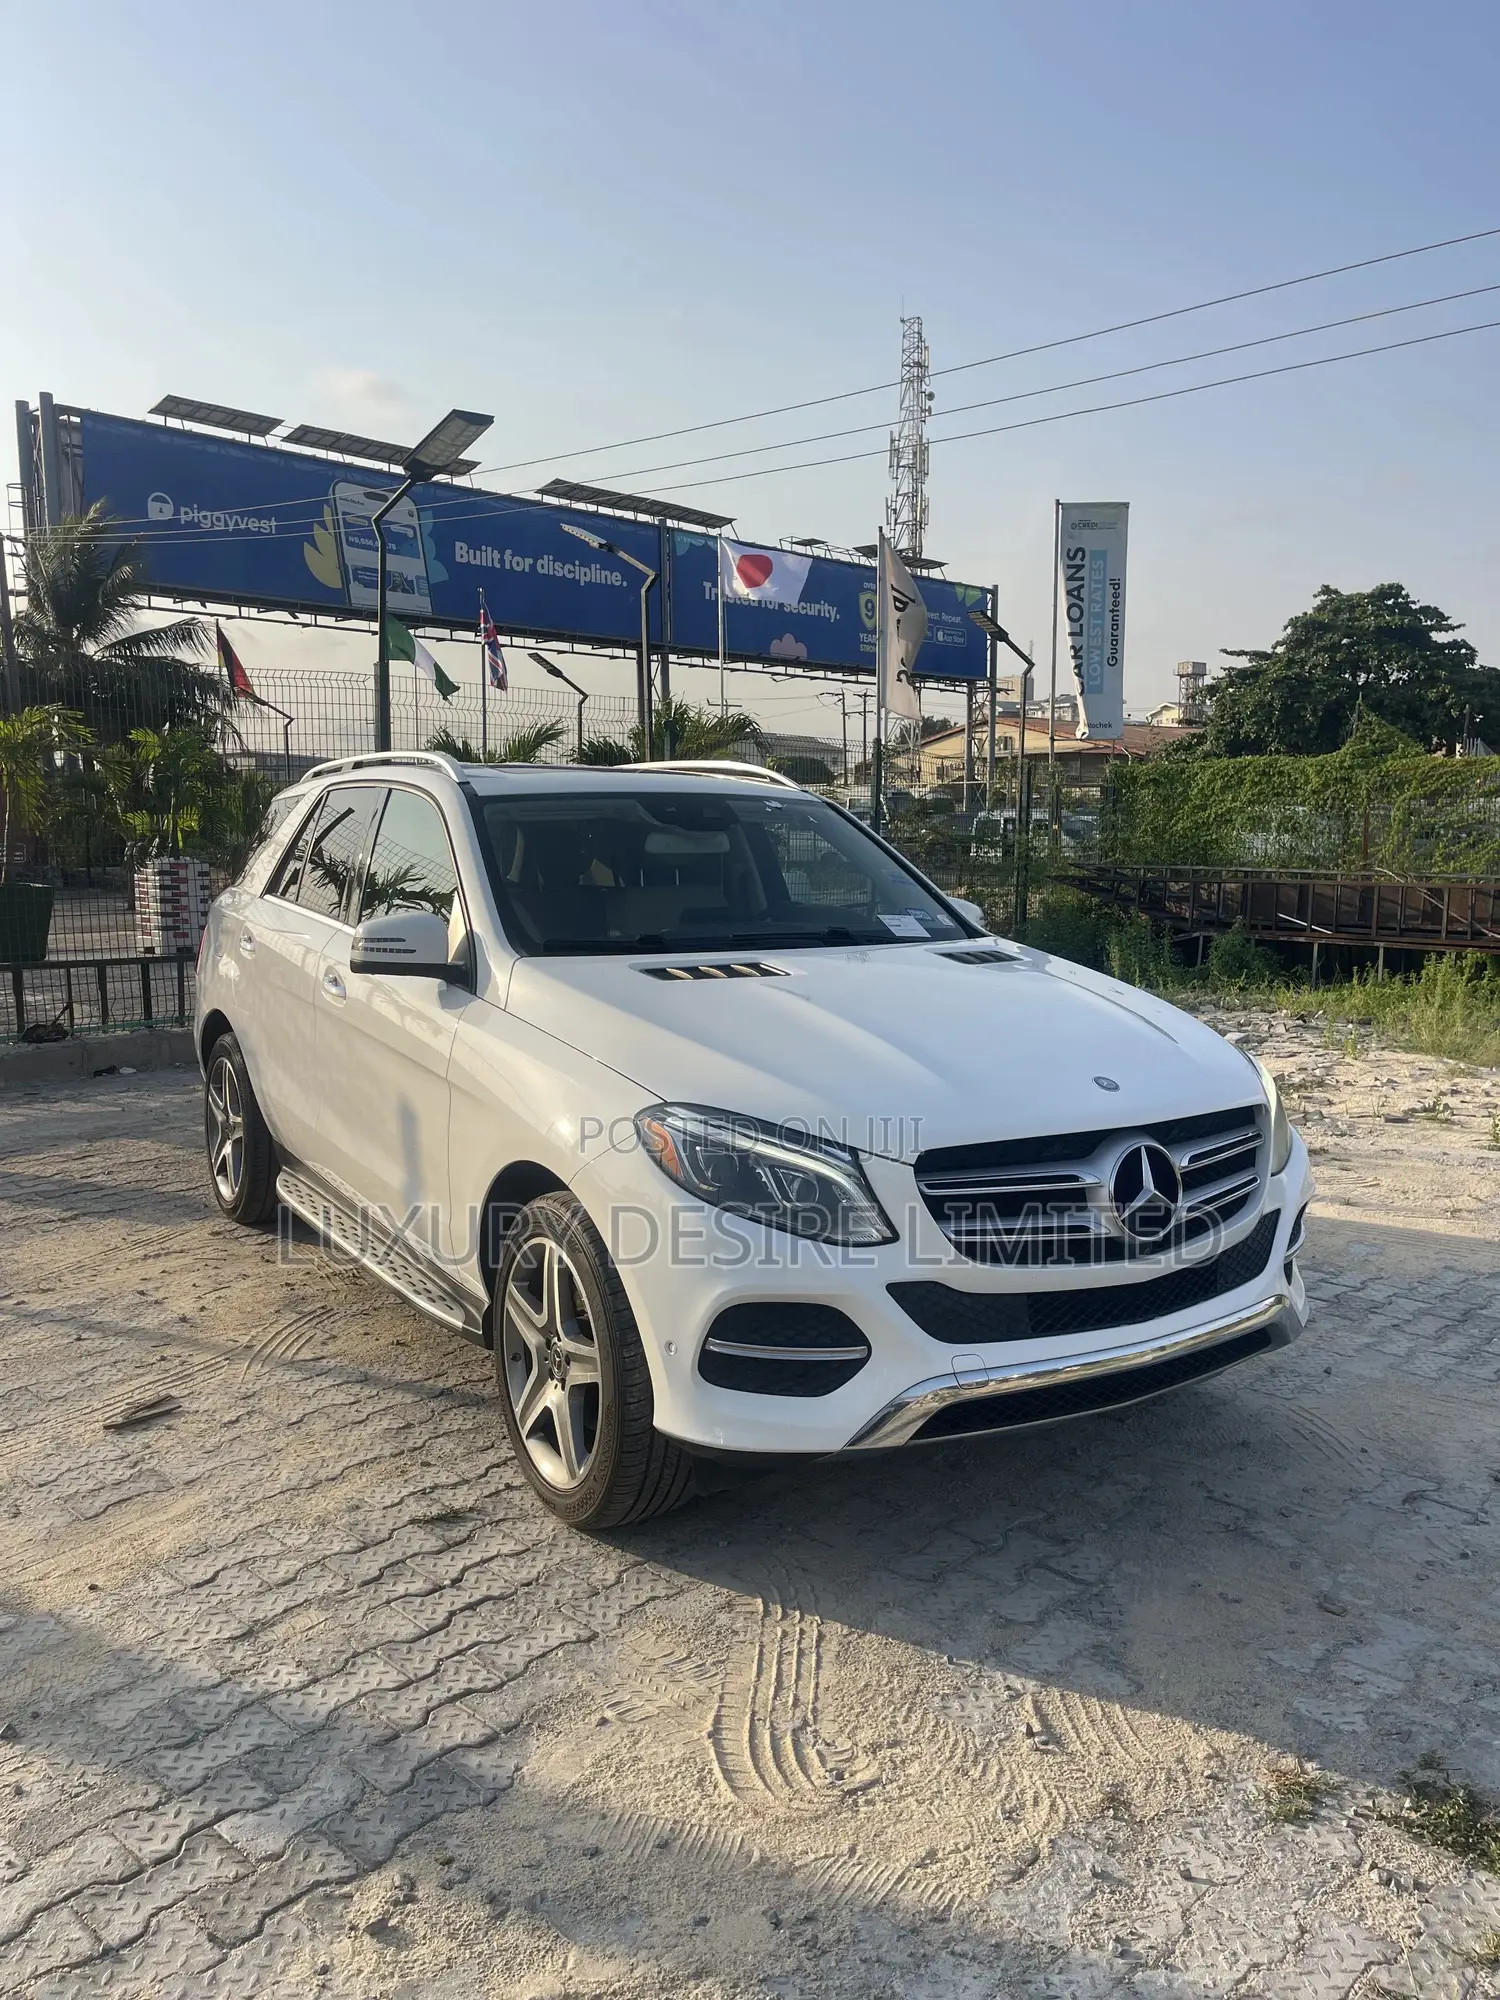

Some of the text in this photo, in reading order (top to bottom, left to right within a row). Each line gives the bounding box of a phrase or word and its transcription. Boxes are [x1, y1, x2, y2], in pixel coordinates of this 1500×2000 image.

[180, 504, 276, 534] piggyvest
[454, 541, 628, 587] Built for discipline.
[783, 600, 840, 622] security.
[864, 598, 875, 620] 9
[1066, 546, 1086, 637] LOANS
[1089, 560, 1104, 685] LOWEST RATES
[1107, 578, 1121, 667] Guaranteed!
